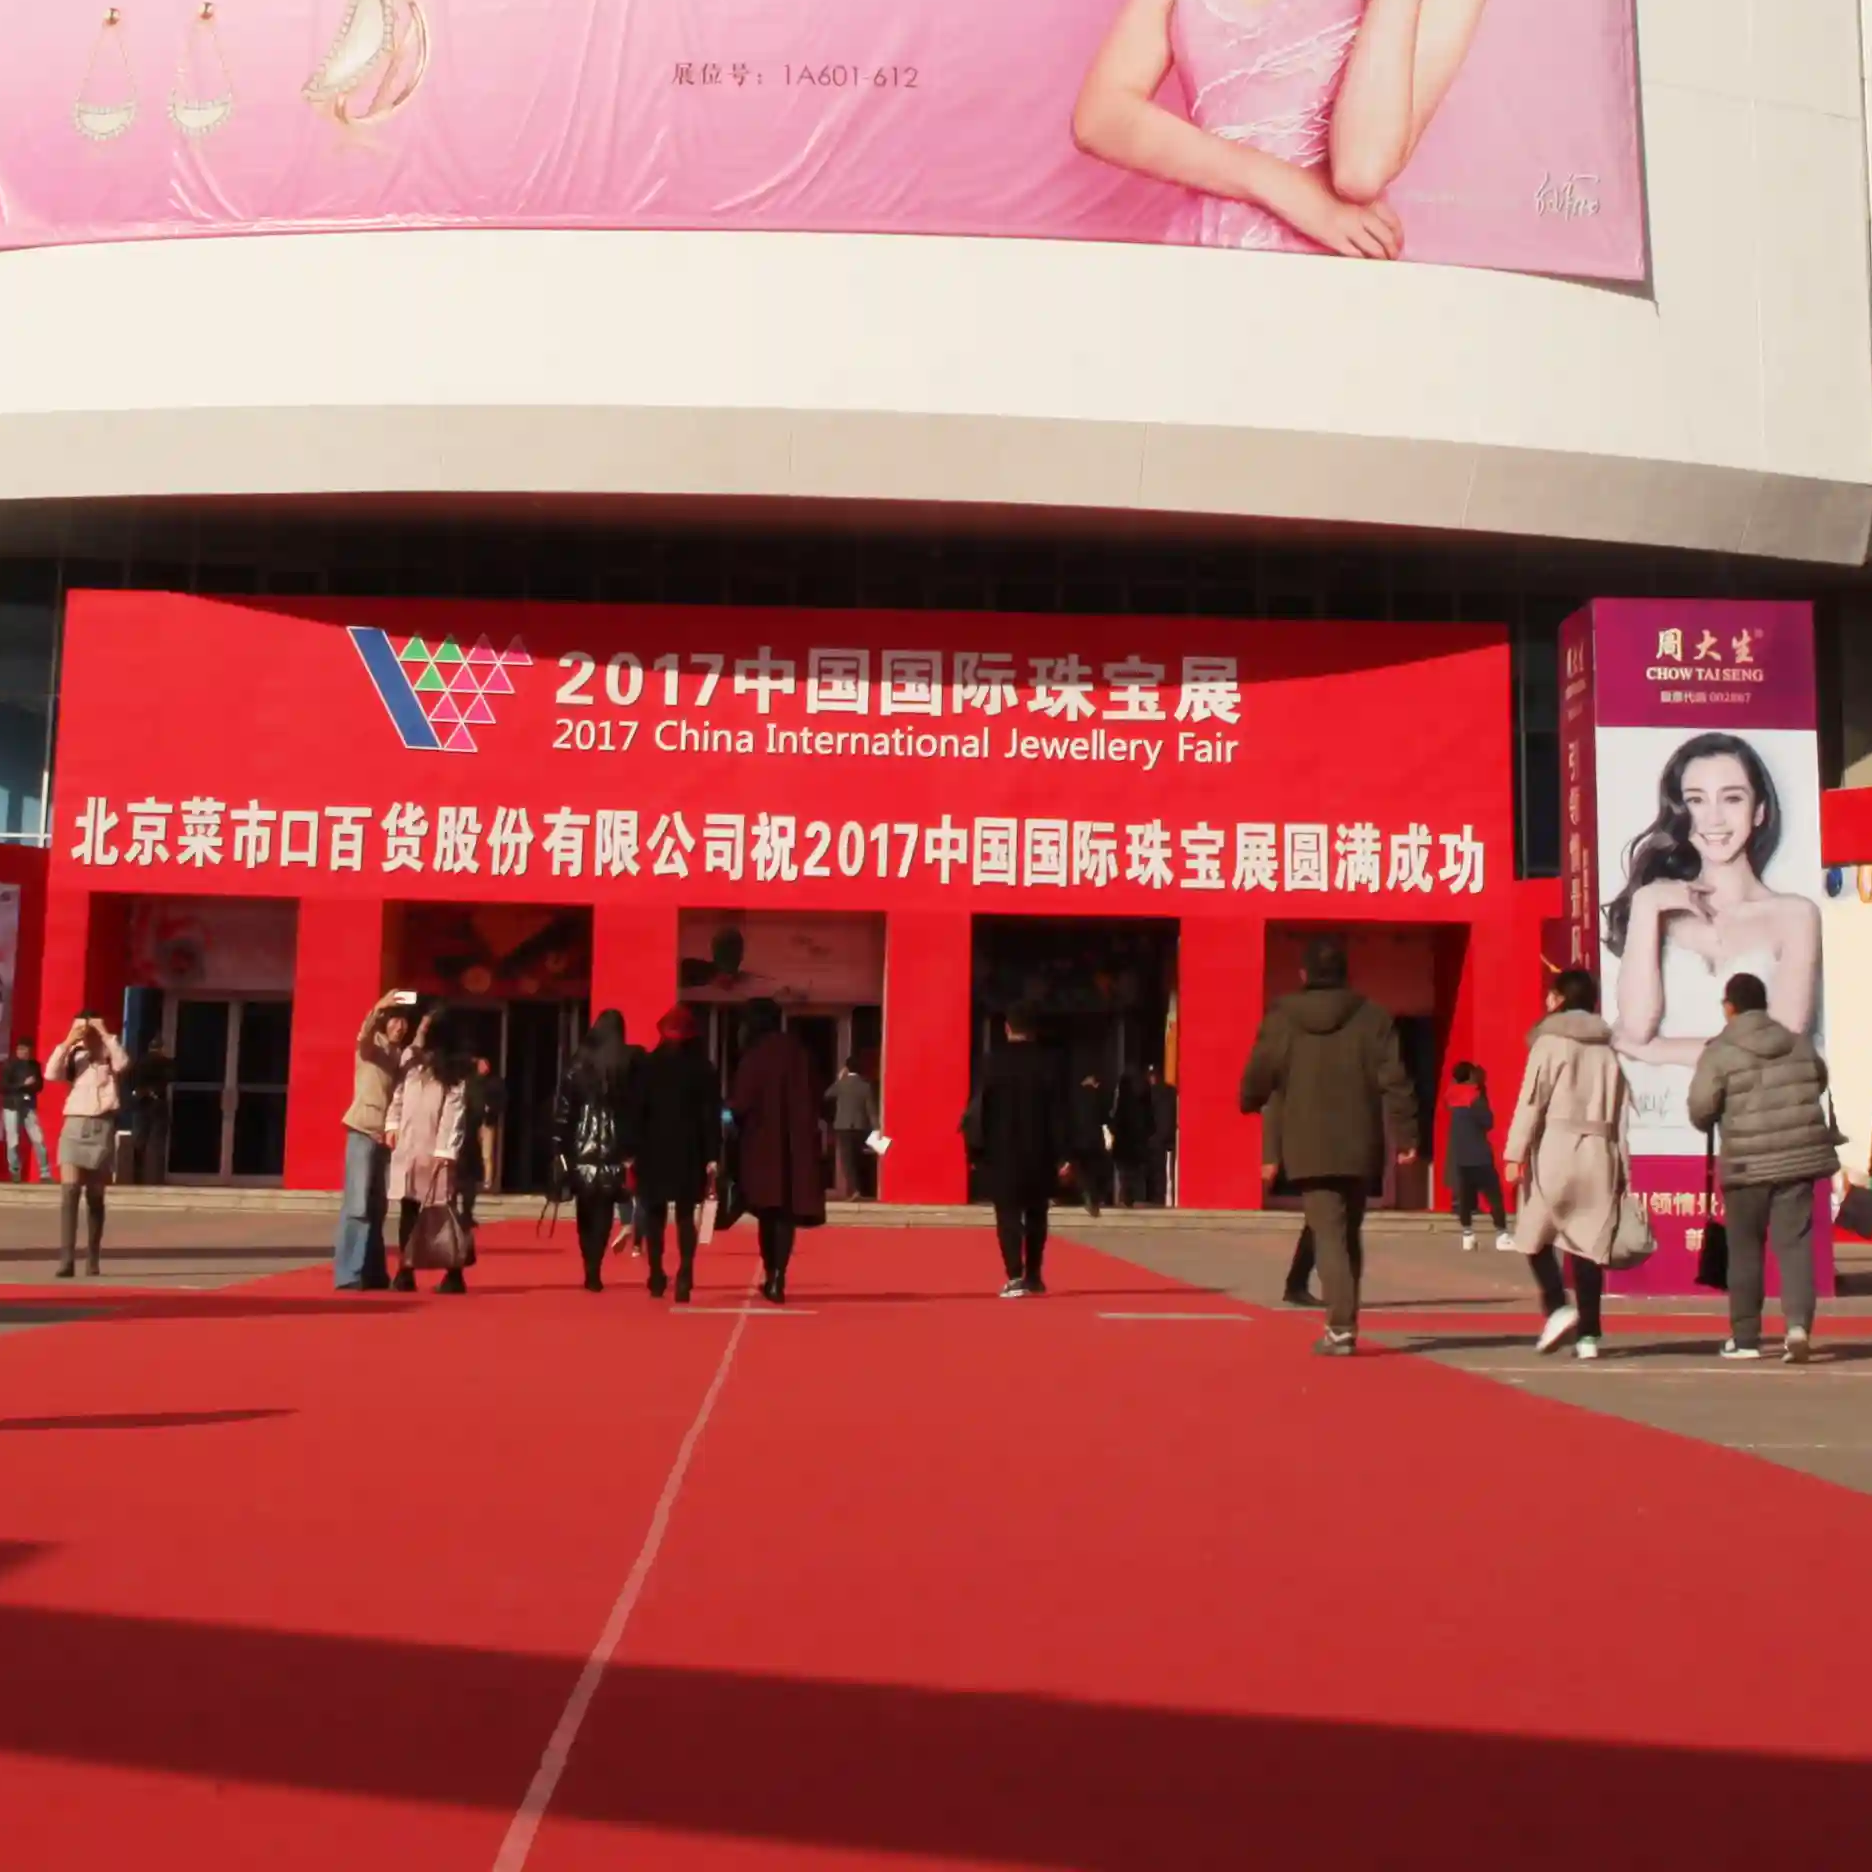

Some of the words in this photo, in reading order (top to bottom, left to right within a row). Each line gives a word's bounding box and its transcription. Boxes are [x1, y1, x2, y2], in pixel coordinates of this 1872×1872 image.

[1656, 628, 1755, 663] 周大生
[554, 644, 1243, 725] 2017中国国际珠宝展
[1646, 666, 1694, 680] CHOW
[1694, 668, 1720, 681] TAI
[1721, 669, 1765, 683] SENG
[553, 718, 639, 753] 2017
[654, 719, 754, 754] China
[766, 722, 989, 761] International
[1004, 730, 1163, 771] Jewellery
[1177, 733, 1240, 765] Fair
[71, 795, 1486, 896] 北京菜市口百货股份有限公司祝2017中国国际珠宝展圆满成功
